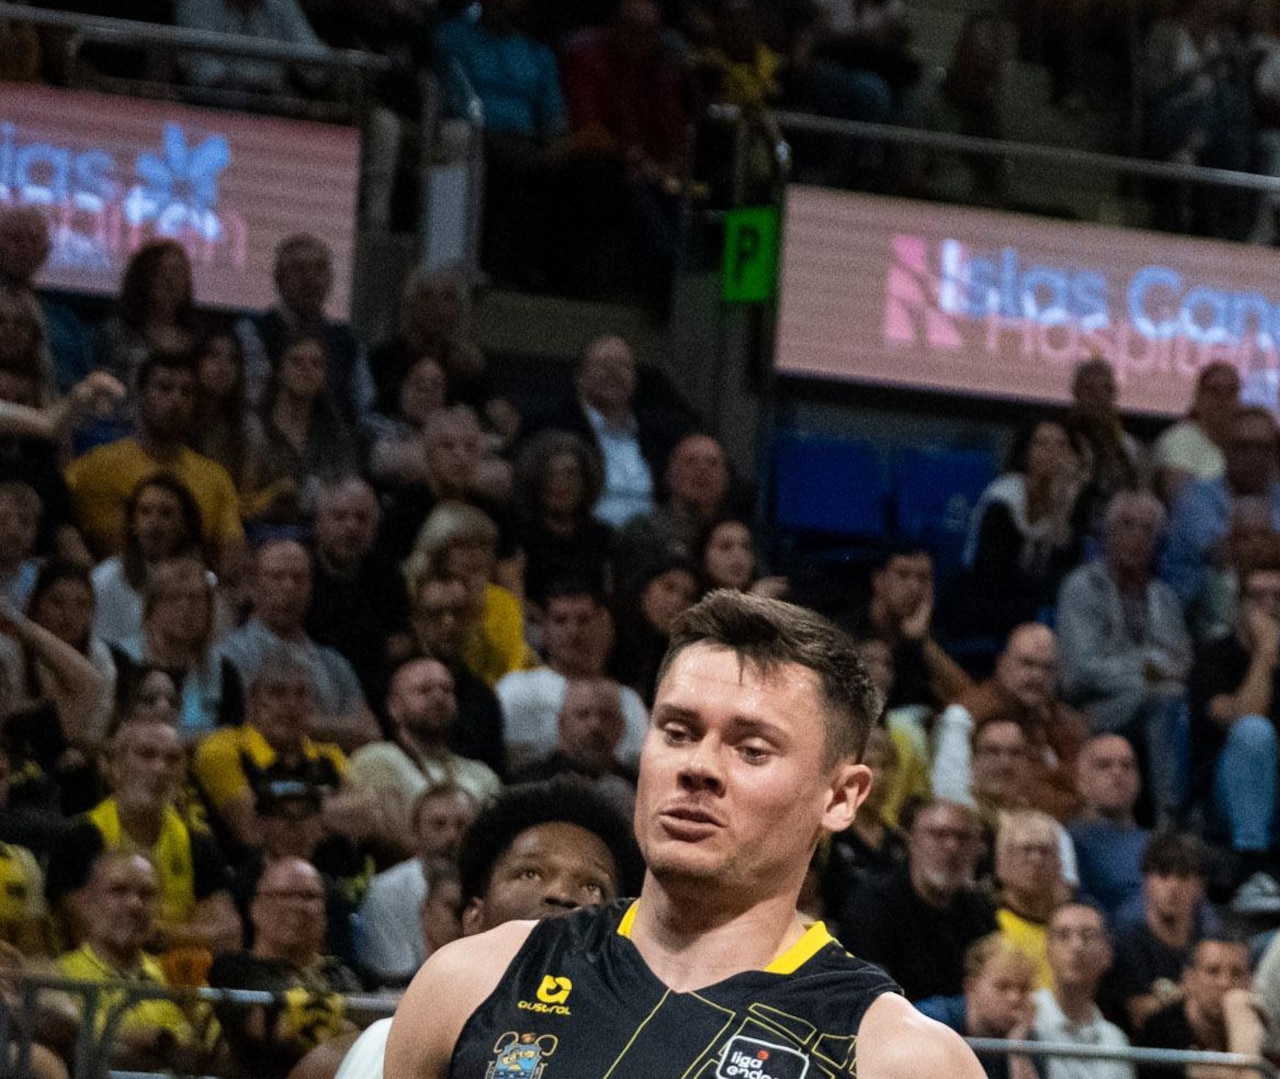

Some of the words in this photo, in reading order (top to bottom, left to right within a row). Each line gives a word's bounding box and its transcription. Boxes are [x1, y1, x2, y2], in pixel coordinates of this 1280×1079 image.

[938, 238, 1109, 331] Islas
[517, 1000, 572, 1015] austral
[731, 1051, 763, 1069] liga
